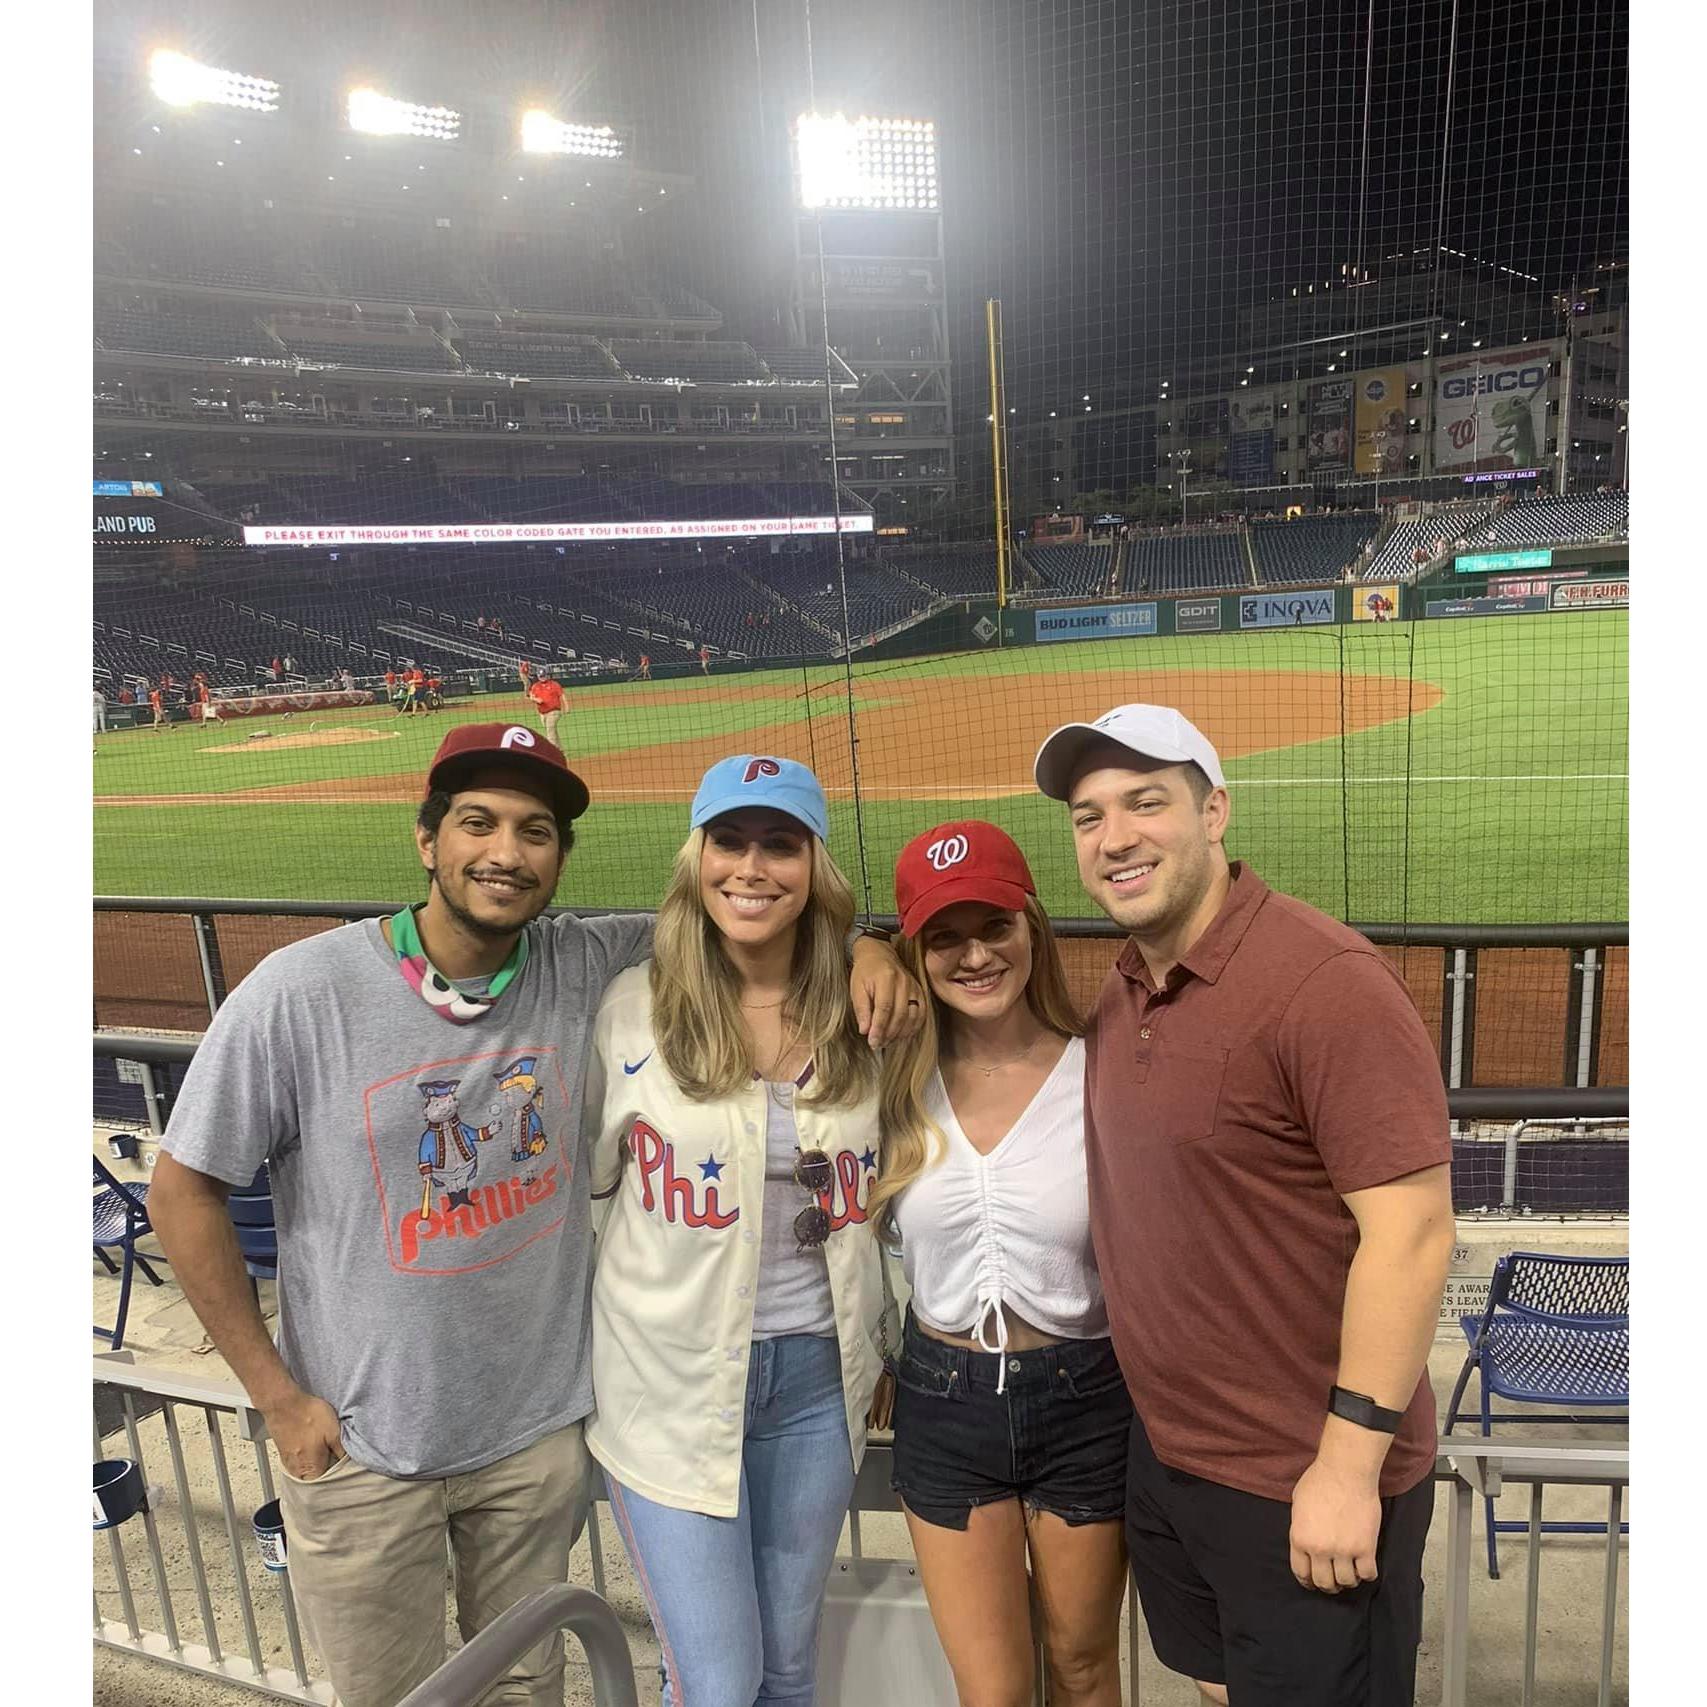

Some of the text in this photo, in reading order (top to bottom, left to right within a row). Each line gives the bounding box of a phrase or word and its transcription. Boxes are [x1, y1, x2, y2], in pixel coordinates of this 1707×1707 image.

[1443, 367, 1544, 399] GEICO
[1464, 474, 1492, 483] ADANCE
[1494, 473, 1515, 481] TICKET
[128, 516, 156, 533] PUB
[265, 530, 313, 540] PLEASE
[318, 530, 345, 540] EXIT
[351, 529, 408, 540] THROUGH
[413, 529, 433, 538] THE
[439, 528, 469, 538] SAME
[474, 528, 512, 538] COLOR
[517, 527, 554, 537] CODED
[558, 527, 585, 536] GATE
[590, 527, 611, 536] YOU
[687, 524, 738, 534] ASSIGNED
[742, 524, 757, 532] ON
[760, 522, 787, 532] YOUR
[791, 521, 818, 531] GAME
[1179, 605, 1218, 617] GDIT
[1264, 598, 1332, 618] INOVA
[1040, 609, 1151, 631] BUD LIGHT SELTZER
[500, 725, 536, 749] P
[742, 756, 781, 785] P
[926, 833, 970, 871] W
[1458, 1284, 1491, 1293] AWAR
[1457, 1296, 1487, 1306] LEAV
